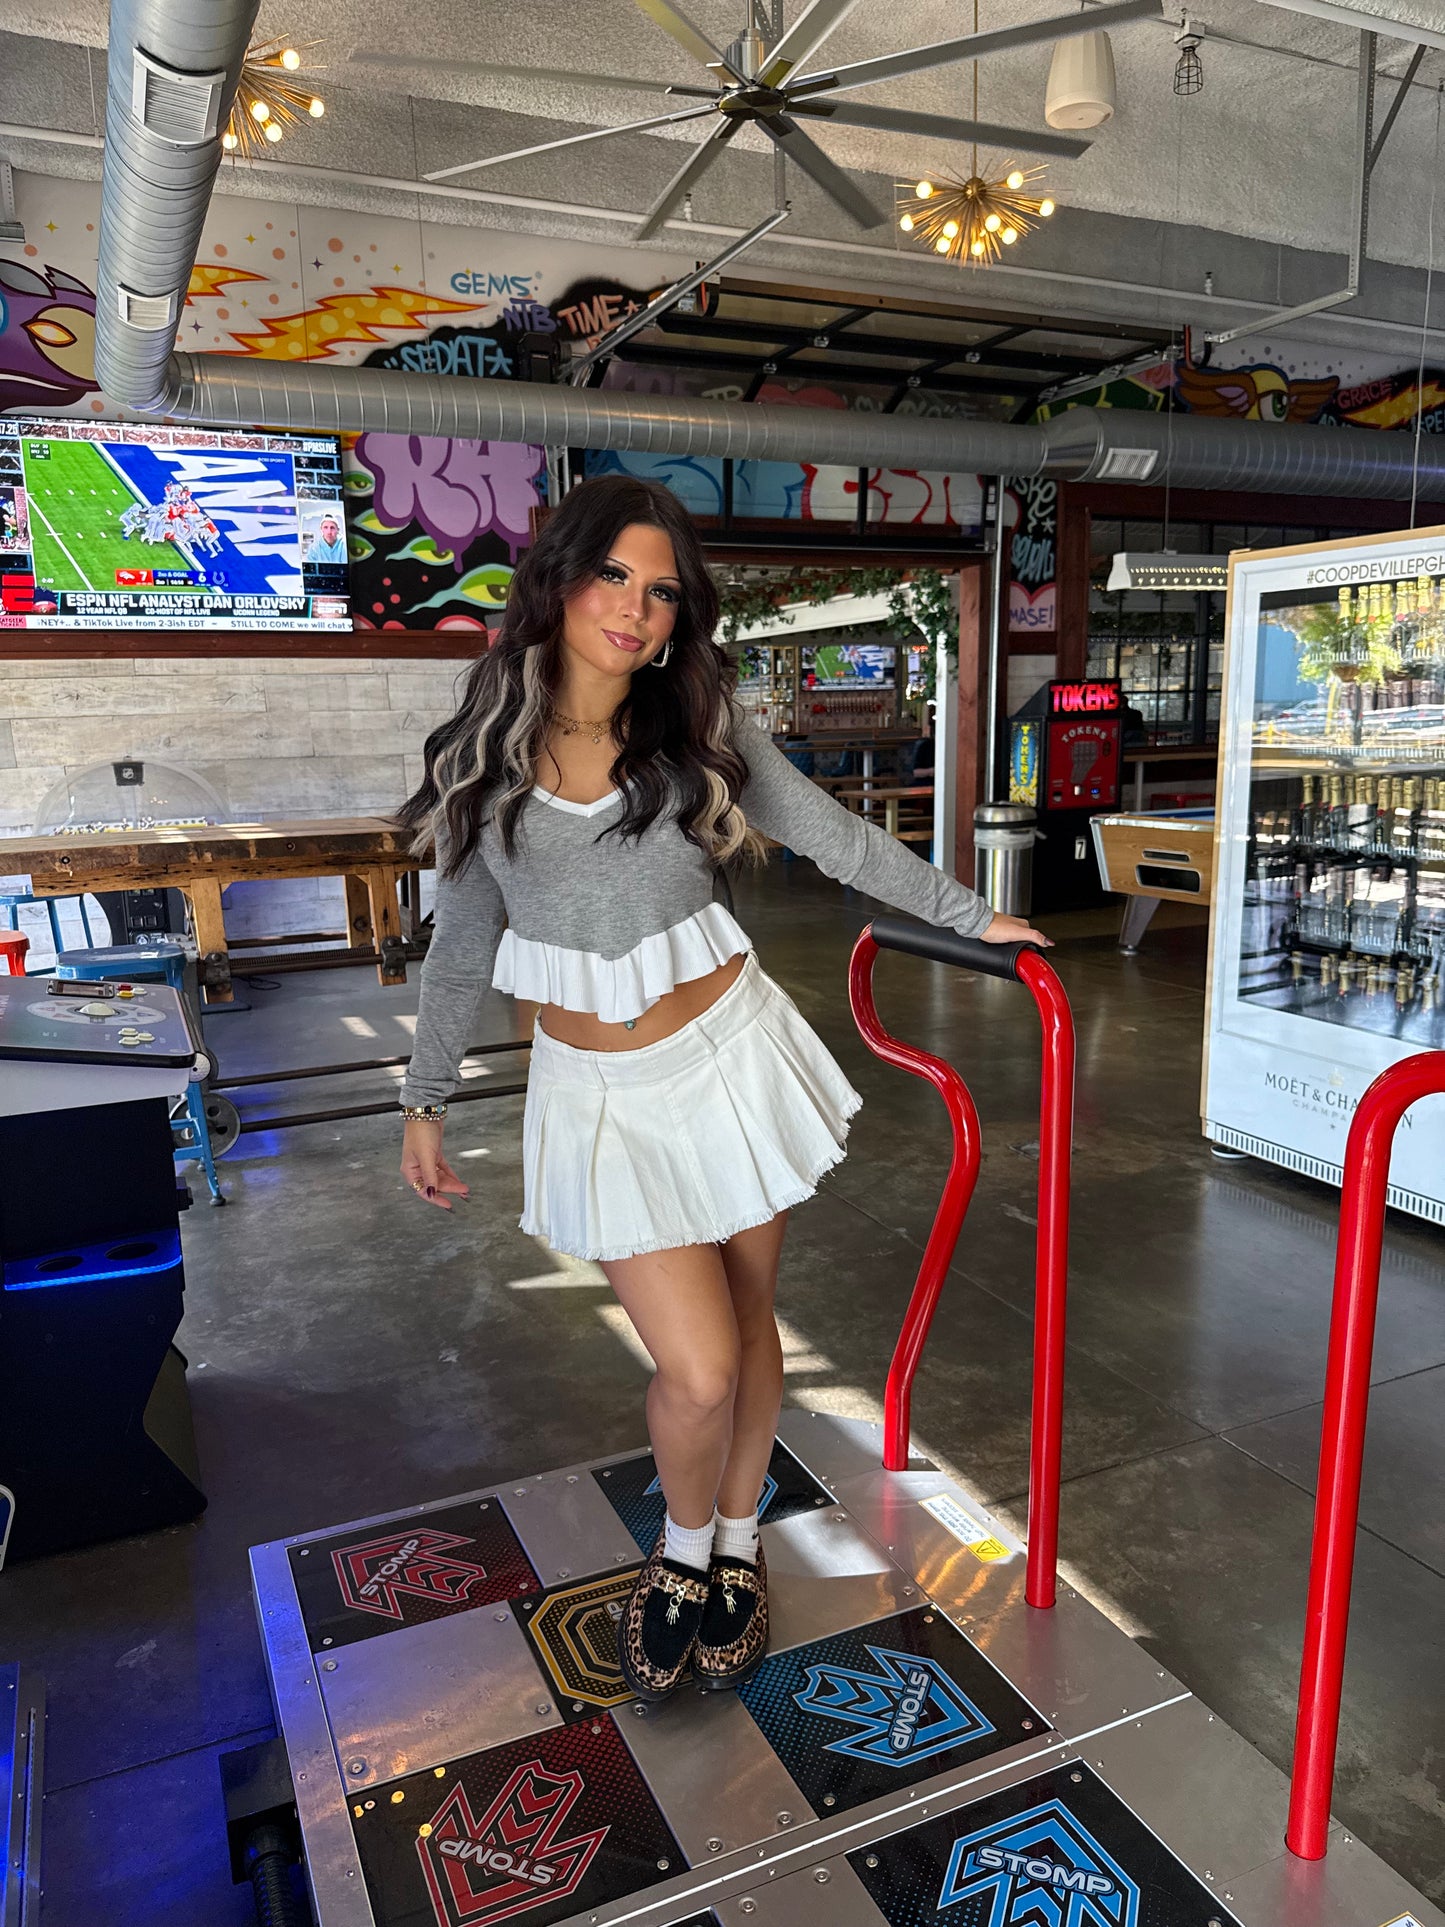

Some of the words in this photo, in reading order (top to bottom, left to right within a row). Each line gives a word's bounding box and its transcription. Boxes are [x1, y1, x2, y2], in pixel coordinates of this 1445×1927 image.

[1337, 378, 1392, 409] GRACE
[139, 571, 147, 581] 7
[198, 573, 206, 583] 6
[66, 594, 106, 608] ESPN
[108, 595, 137, 608] NFL
[139, 595, 201, 609] ANALYST
[203, 596, 232, 609] DAN
[234, 597, 305, 610] ORLOVSKY
[83, 619, 113, 627] TikTok
[115, 619, 133, 627] Live
[188, 620, 205, 628] EDT
[231, 620, 254, 628] STILL
[269, 621, 295, 629] COME
[328, 622, 346, 630] chat
[1051, 684, 1119, 712] TOKENS
[1062, 726, 1107, 743] TOKENS
[1021, 726, 1030, 784] TOKENS
[1265, 1072, 1310, 1098] MOËT
[1312, 1089, 1321, 1103] &
[360, 1539, 419, 1596] STOMP
[893, 1671, 929, 1750] STOMP
[439, 1839, 556, 1885] STOMP
[979, 1847, 1112, 1894] STOMP
